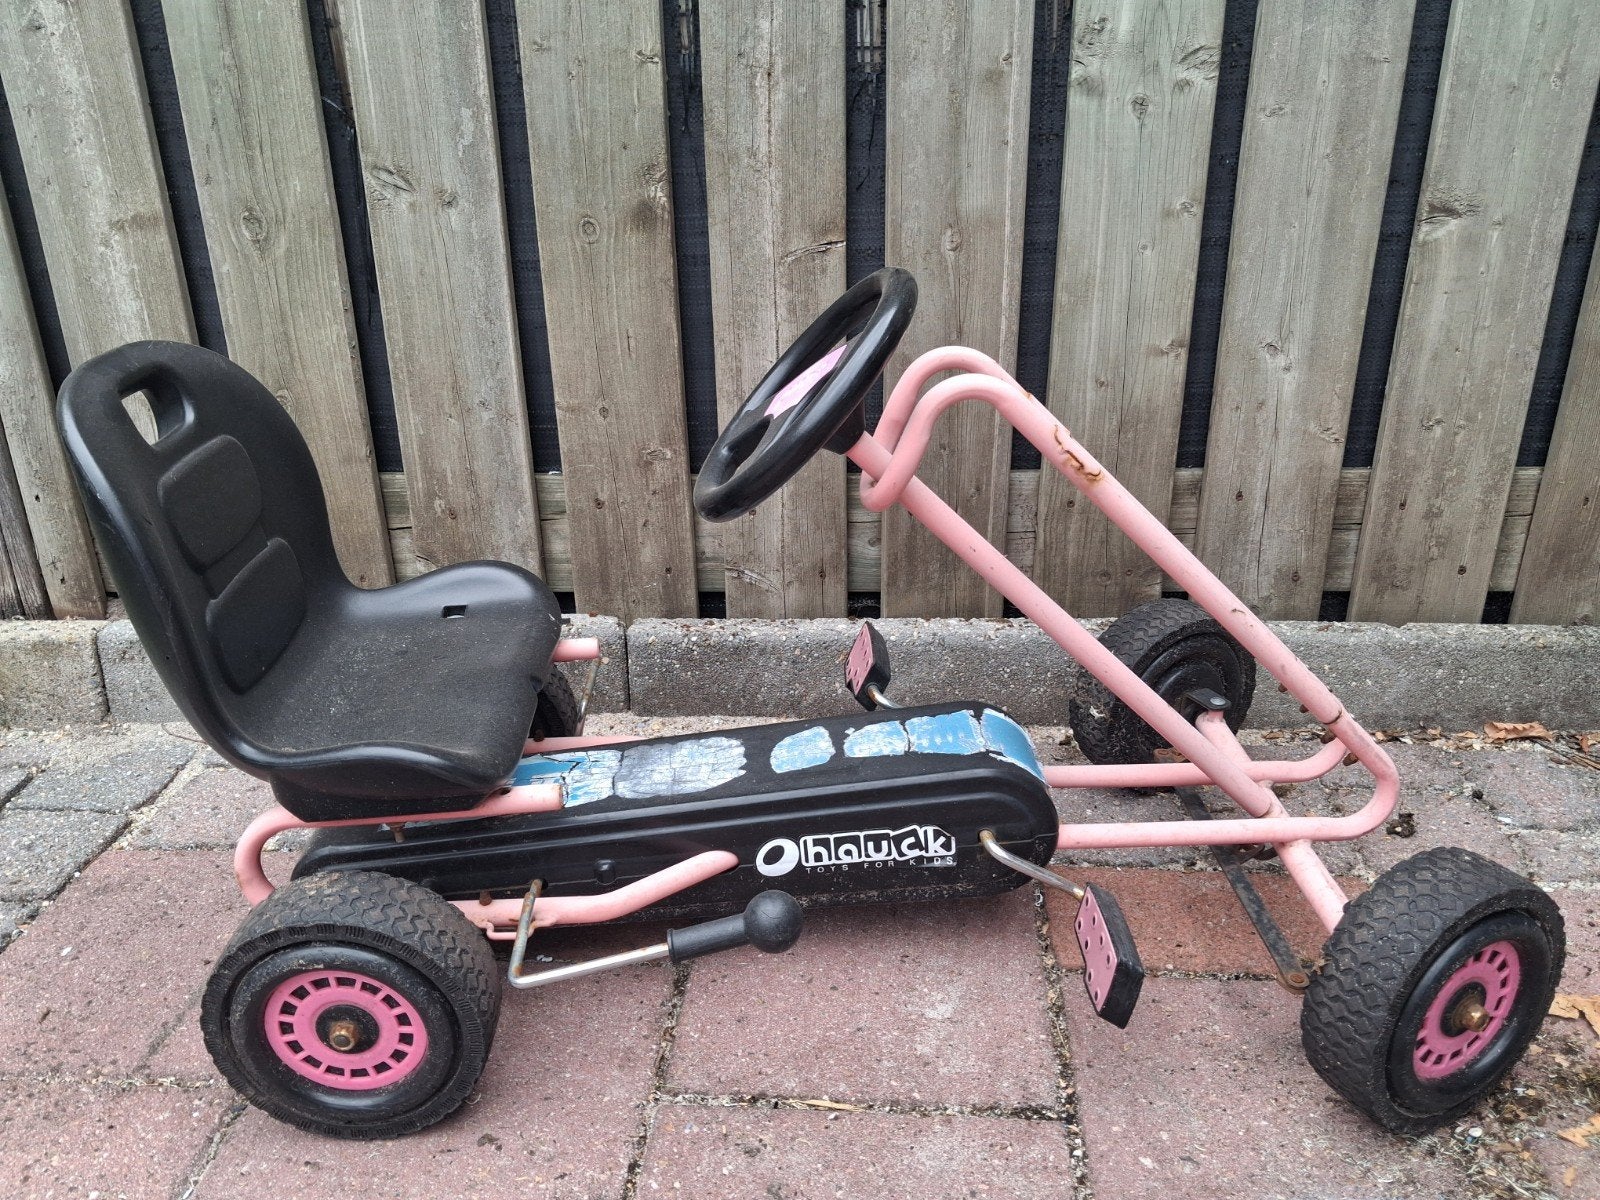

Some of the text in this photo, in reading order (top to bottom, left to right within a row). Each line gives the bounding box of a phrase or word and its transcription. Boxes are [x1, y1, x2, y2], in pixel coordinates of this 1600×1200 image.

[805, 857, 955, 874] TOYS FOR KIDS
